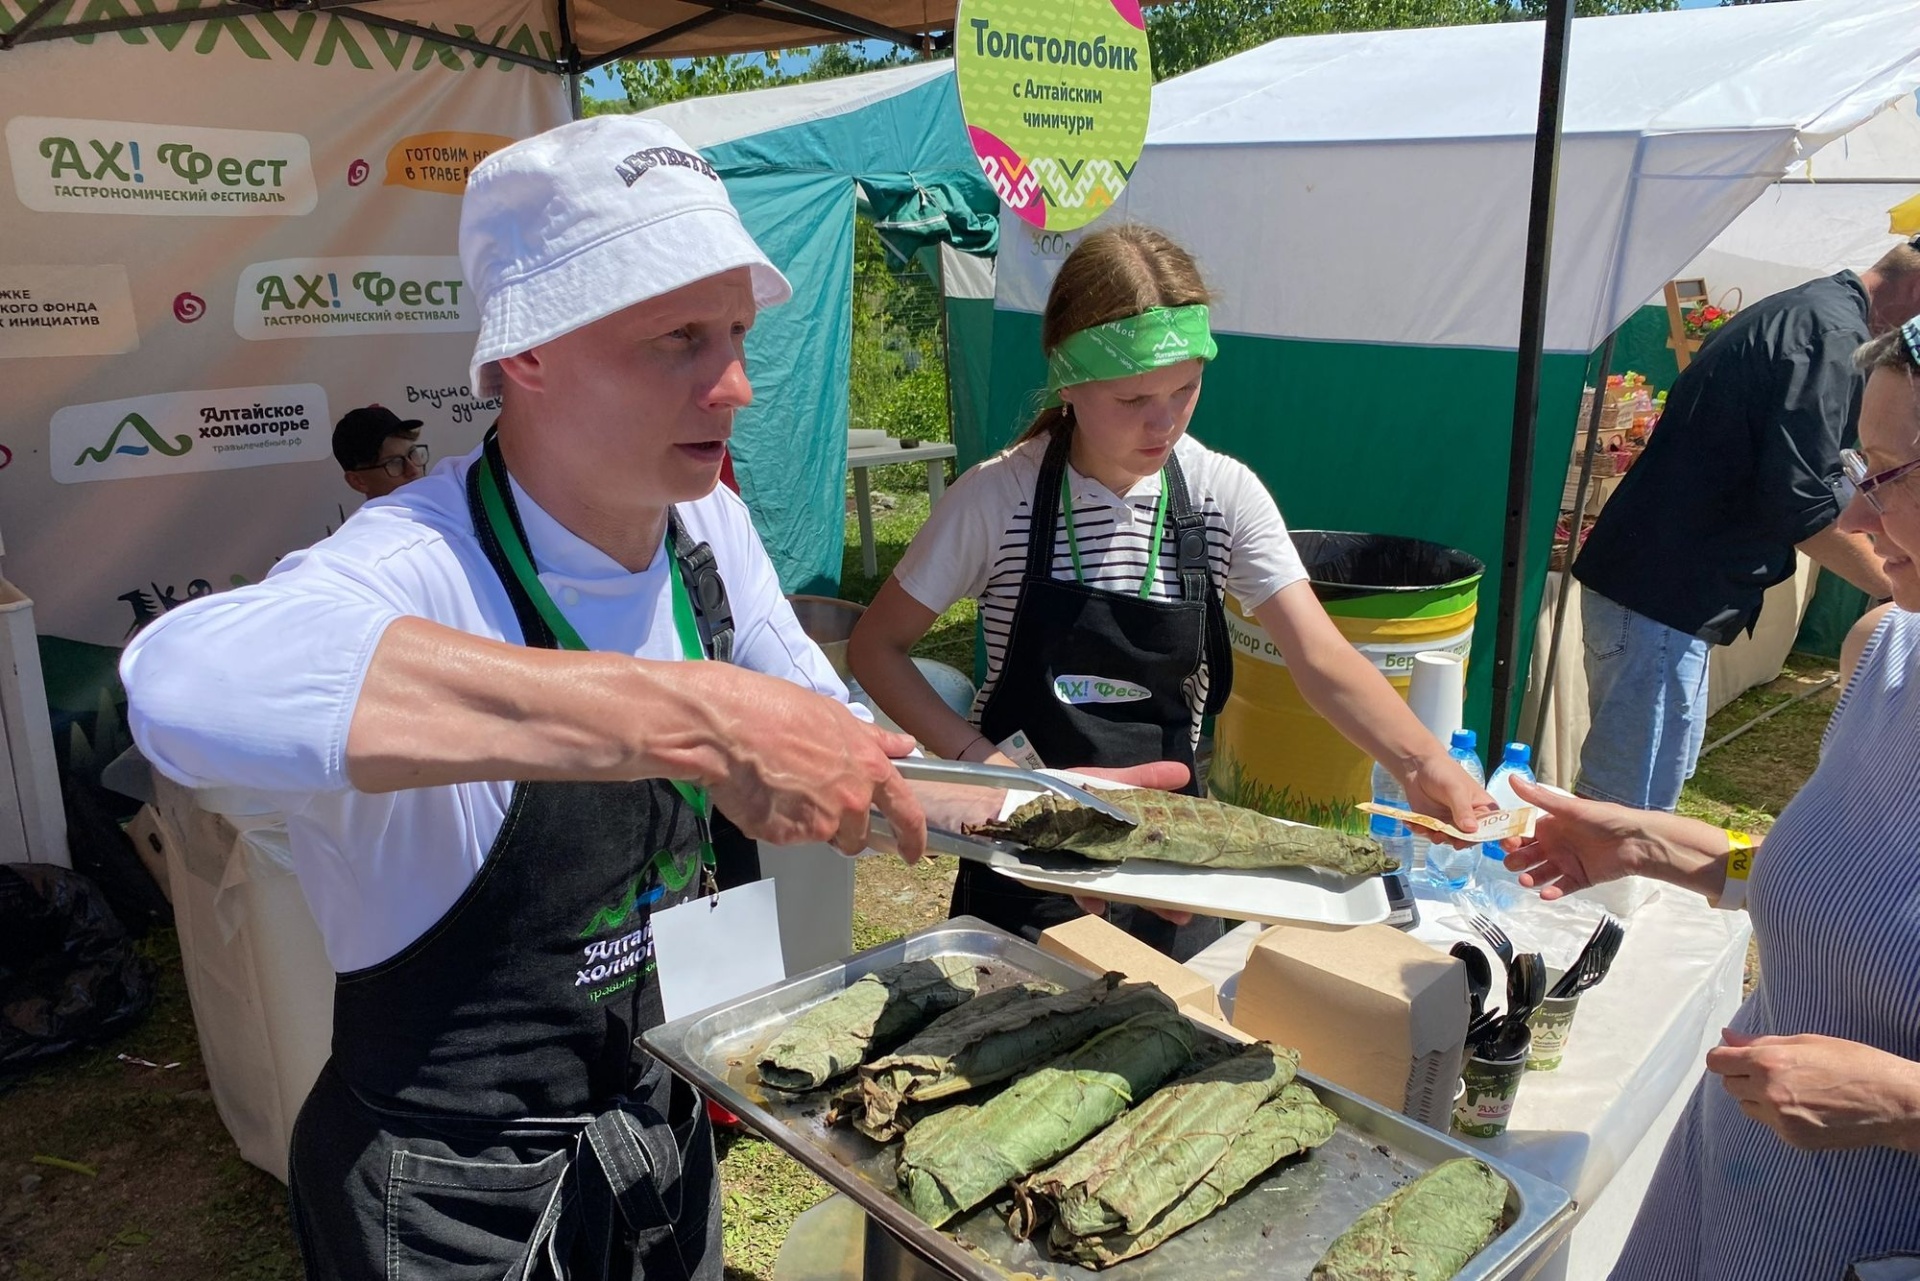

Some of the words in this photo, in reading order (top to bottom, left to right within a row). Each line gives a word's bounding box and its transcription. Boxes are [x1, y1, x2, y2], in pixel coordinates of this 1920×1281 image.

[970, 18, 1138, 72] Толстолобик
[1013, 82, 1021, 97] с
[1024, 78, 1103, 104] Алтайским
[1023, 112, 1094, 136] чимичури
[39, 136, 144, 184] АХ!
[156, 142, 288, 187] Фест
[405, 146, 468, 162] ГОТОВИМ
[405, 167, 416, 180] В
[54, 184, 208, 202] ГАСТРОНОМИЧЕСКИЙ
[210, 190, 286, 203] ФЕСТИВАЛЬ
[256, 272, 342, 311] АХ!
[352, 271, 464, 307] Фест
[43, 302, 98, 313] ФОНДА
[9, 316, 100, 328] ИНИЦИАТИВ
[263, 309, 392, 327] ГАСТРОНОМИЧЕСКИЙ
[394, 309, 461, 321] ФЕСТИВАЛЬ
[200, 403, 305, 424] Алтайское
[198, 418, 310, 438] холмогорье
[212, 437, 303, 453] травылечебные.рф
[1384, 653, 1415, 671] Бер
[1093, 681, 1150, 698] Фест
[1481, 812, 1511, 827] 100
